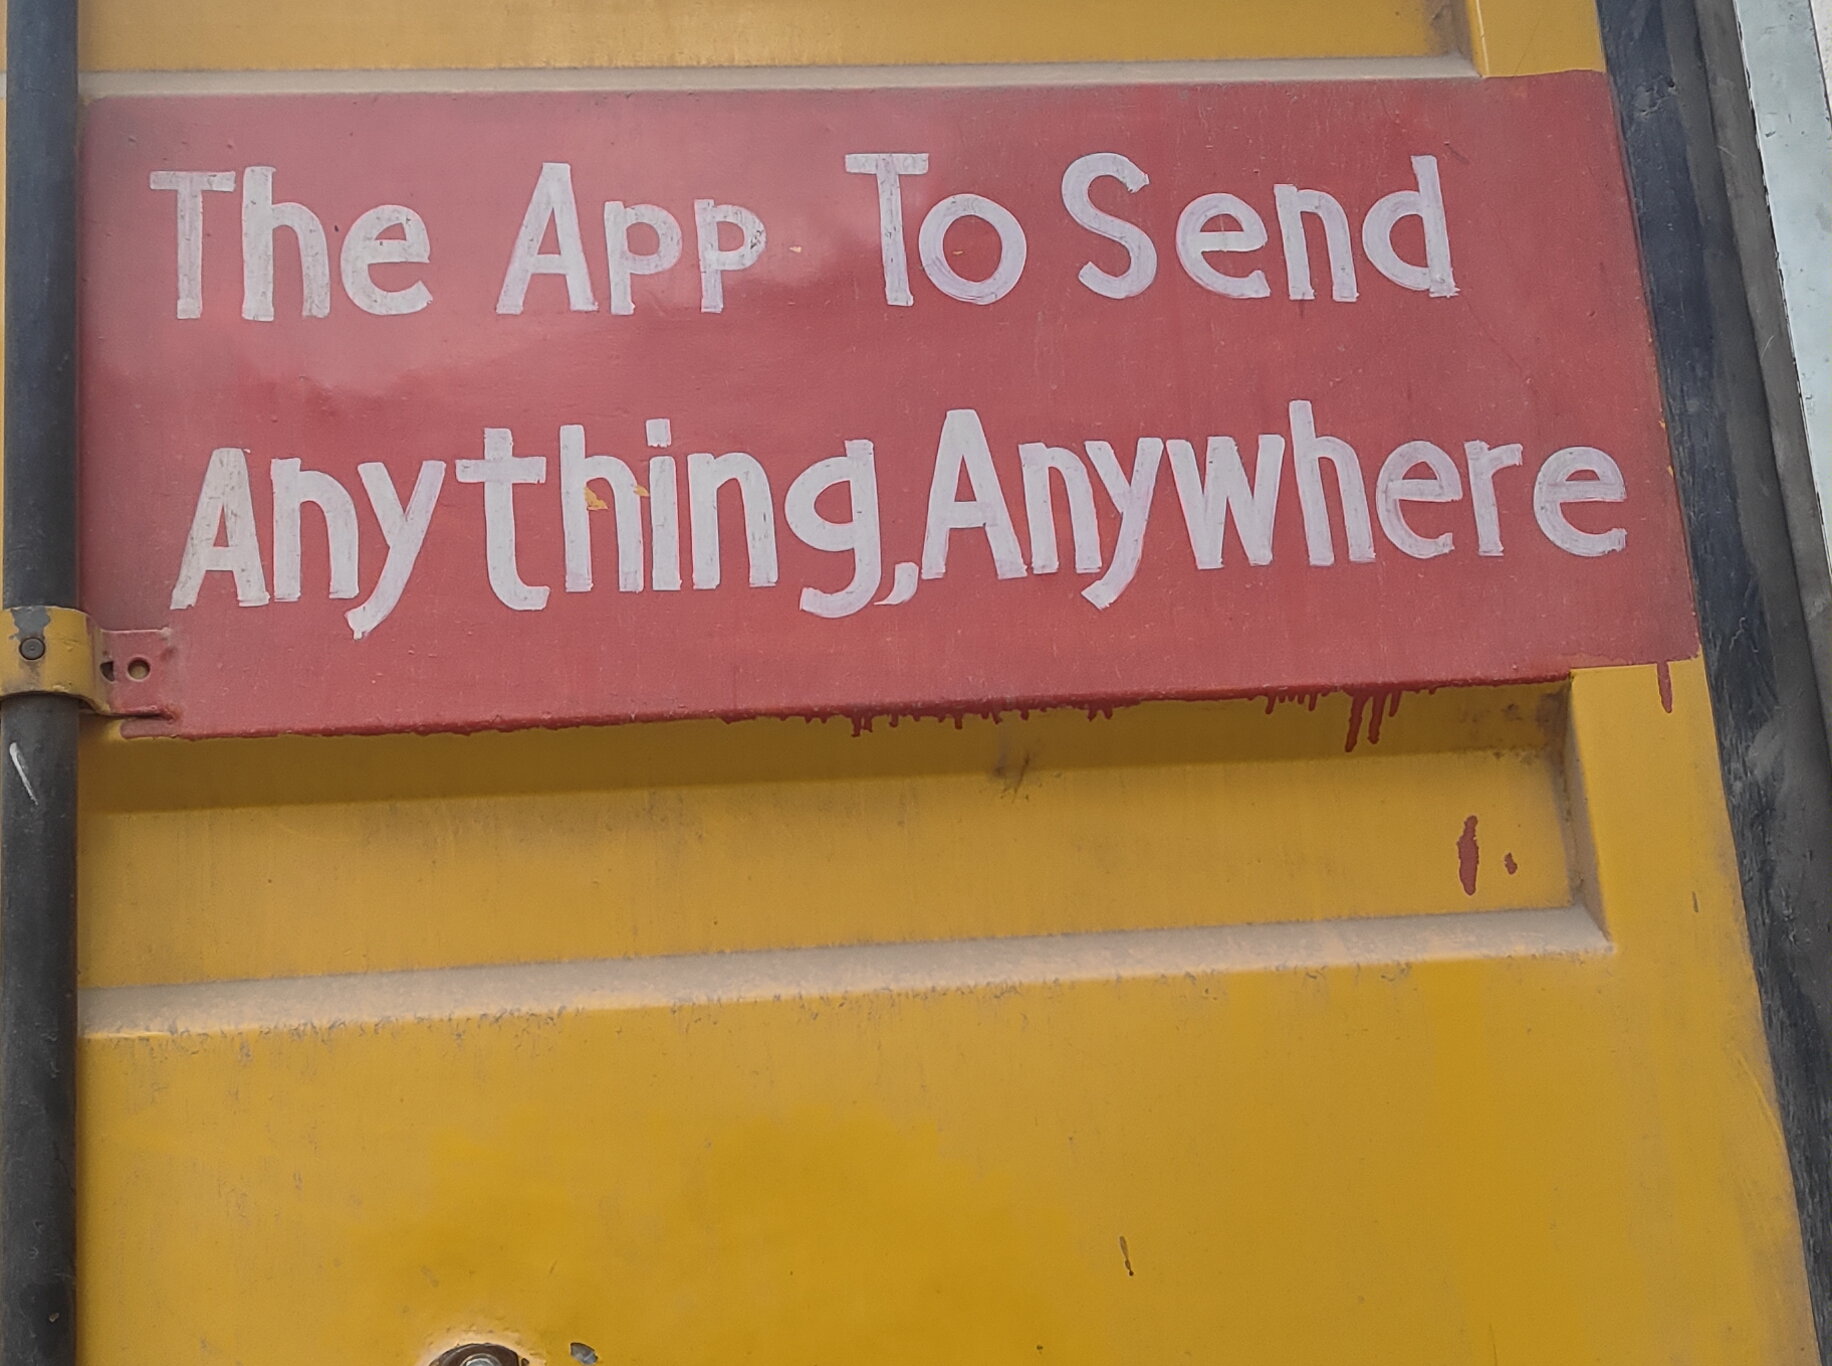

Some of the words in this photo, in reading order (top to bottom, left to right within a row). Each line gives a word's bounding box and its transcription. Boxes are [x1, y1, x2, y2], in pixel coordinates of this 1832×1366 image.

[150, 165, 435, 322] The
[494, 161, 768, 316] App
[844, 152, 1028, 307] To
[1061, 152, 1462, 303] Send
